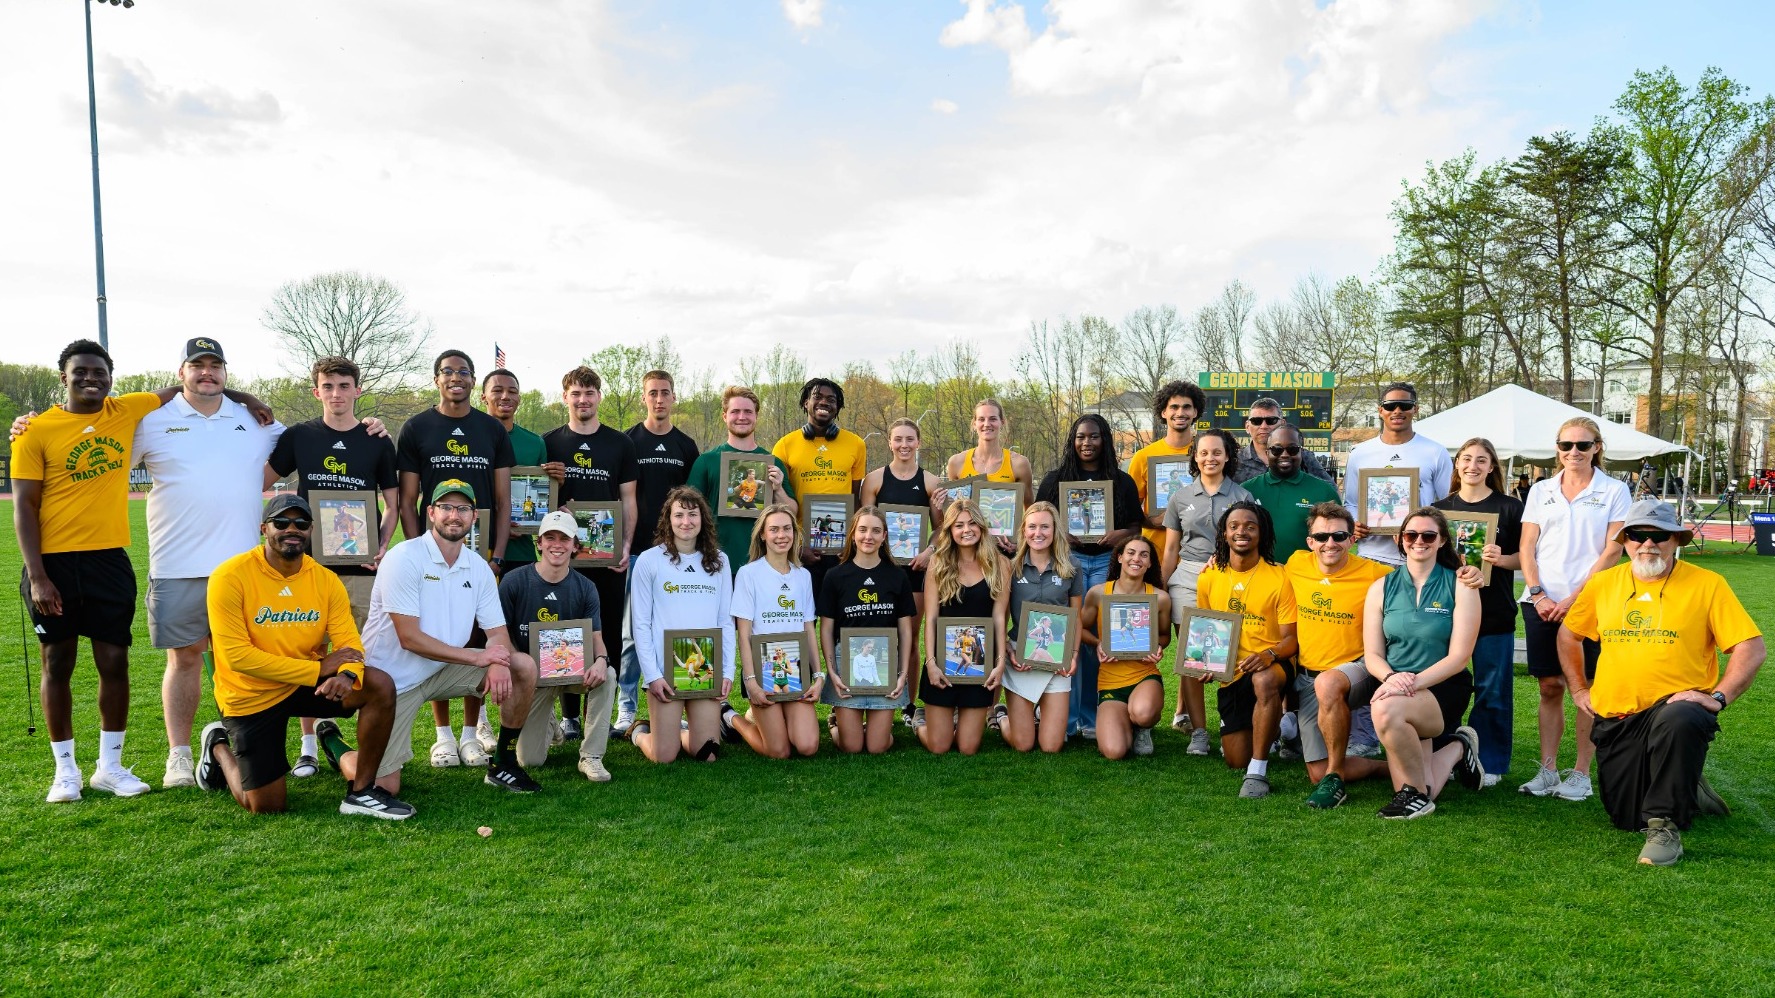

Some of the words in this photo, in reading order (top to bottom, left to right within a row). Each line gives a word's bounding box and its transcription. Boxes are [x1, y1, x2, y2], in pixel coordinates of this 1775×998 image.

[1210, 372, 1266, 388] GEORGE
[1270, 372, 1323, 388] MASON
[66, 439, 93, 470] GEORGE
[94, 436, 124, 454] MASON
[446, 439, 469, 456] GM
[324, 456, 347, 475] GM
[430, 455, 460, 463] GEORGE
[461, 456, 488, 465] MASON
[573, 452, 592, 468] GM
[664, 458, 685, 467] UNITED
[814, 456, 833, 470] GM
[70, 468, 100, 482] TRACK
[585, 468, 609, 477] MASON
[801, 470, 826, 478] GEORGE
[307, 473, 338, 482] GEORGE
[338, 475, 365, 487] MASON
[317, 482, 358, 491] ATHLETICS
[777, 594, 796, 611] GM
[857, 588, 878, 604] GM
[1311, 591, 1333, 610] GM
[254, 606, 321, 625] Patriots
[761, 611, 789, 619] GEORGE
[844, 603, 871, 614] GEORGE
[1323, 611, 1354, 620] MASON
[1602, 629, 1640, 637] GEORGE
[1641, 629, 1679, 639] MASON
